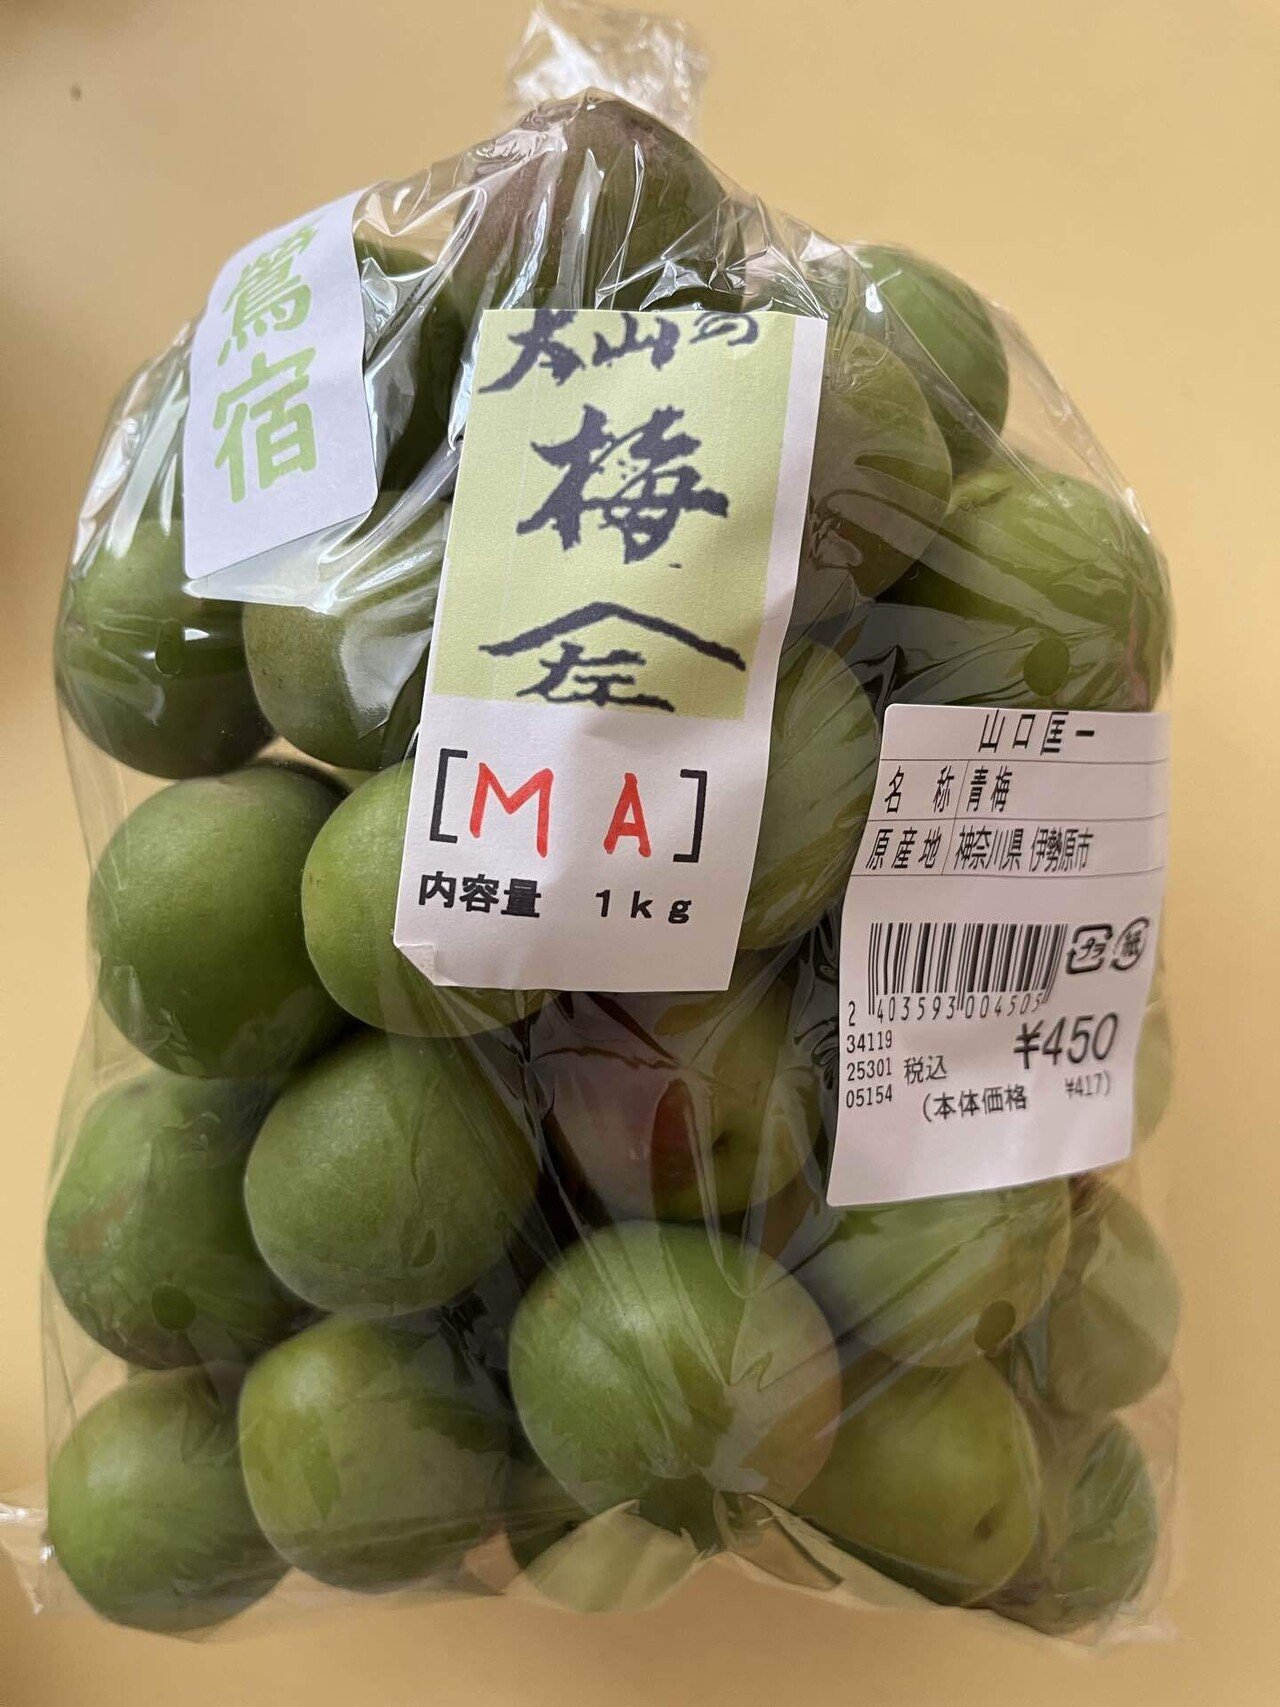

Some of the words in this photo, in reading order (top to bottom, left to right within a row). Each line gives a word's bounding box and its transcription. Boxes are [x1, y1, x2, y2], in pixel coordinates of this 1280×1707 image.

[515, 404, 729, 565] 梅
[978, 709, 1095, 756] 山口匡一
[966, 765, 1013, 813] 青梅
[865, 826, 942, 870] 原産地
[953, 824, 1024, 871] 神奈川県
[1029, 826, 1094, 872] 伊勢原市
[418, 871, 542, 918] 内容量
[846, 1029, 893, 1053] 34119
[1013, 1011, 1119, 1070] ¥450
[846, 1057, 893, 1081] 25301
[903, 1054, 948, 1085] 税込
[846, 1083, 893, 1109] 05154
[922, 1083, 1028, 1122] (本体価格
